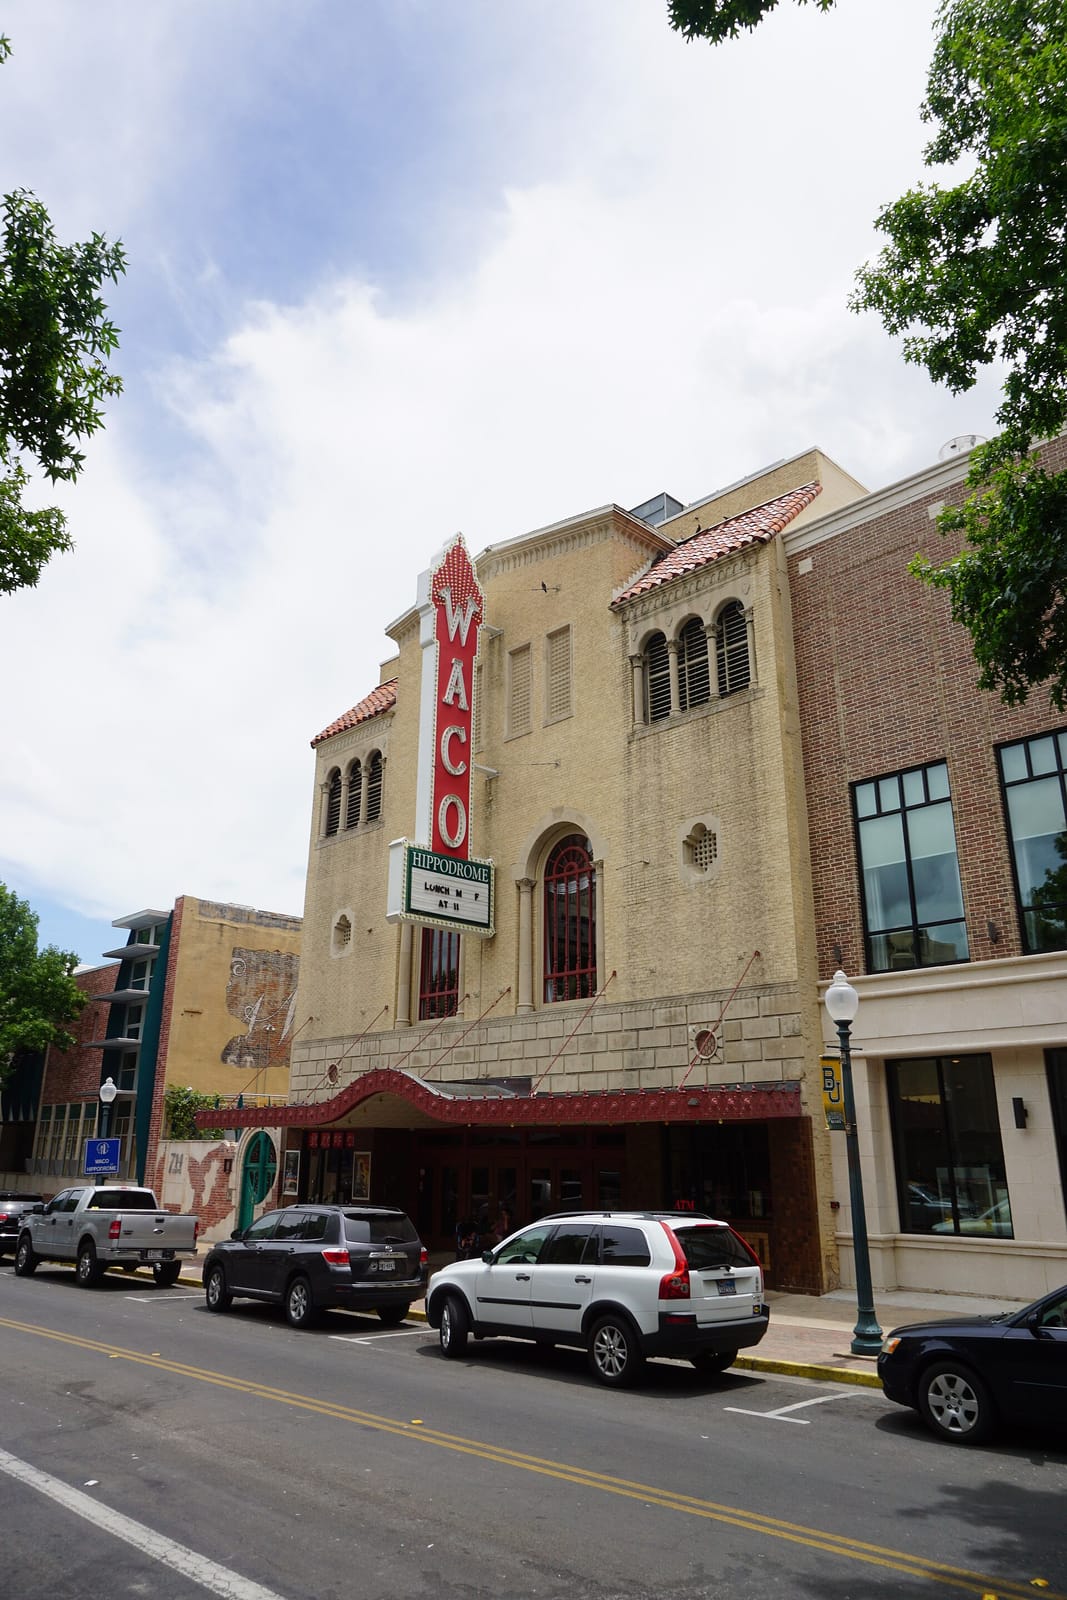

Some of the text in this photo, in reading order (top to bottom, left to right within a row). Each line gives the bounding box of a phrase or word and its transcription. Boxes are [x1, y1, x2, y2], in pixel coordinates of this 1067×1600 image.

[438, 586, 480, 848] WACO
[412, 852, 489, 882] HIPPODROME
[424, 881, 480, 901] LUNCH M F
[438, 899, 449, 909] AT
[822, 1066, 842, 1104] BU
[674, 1199, 695, 1211] ATM
